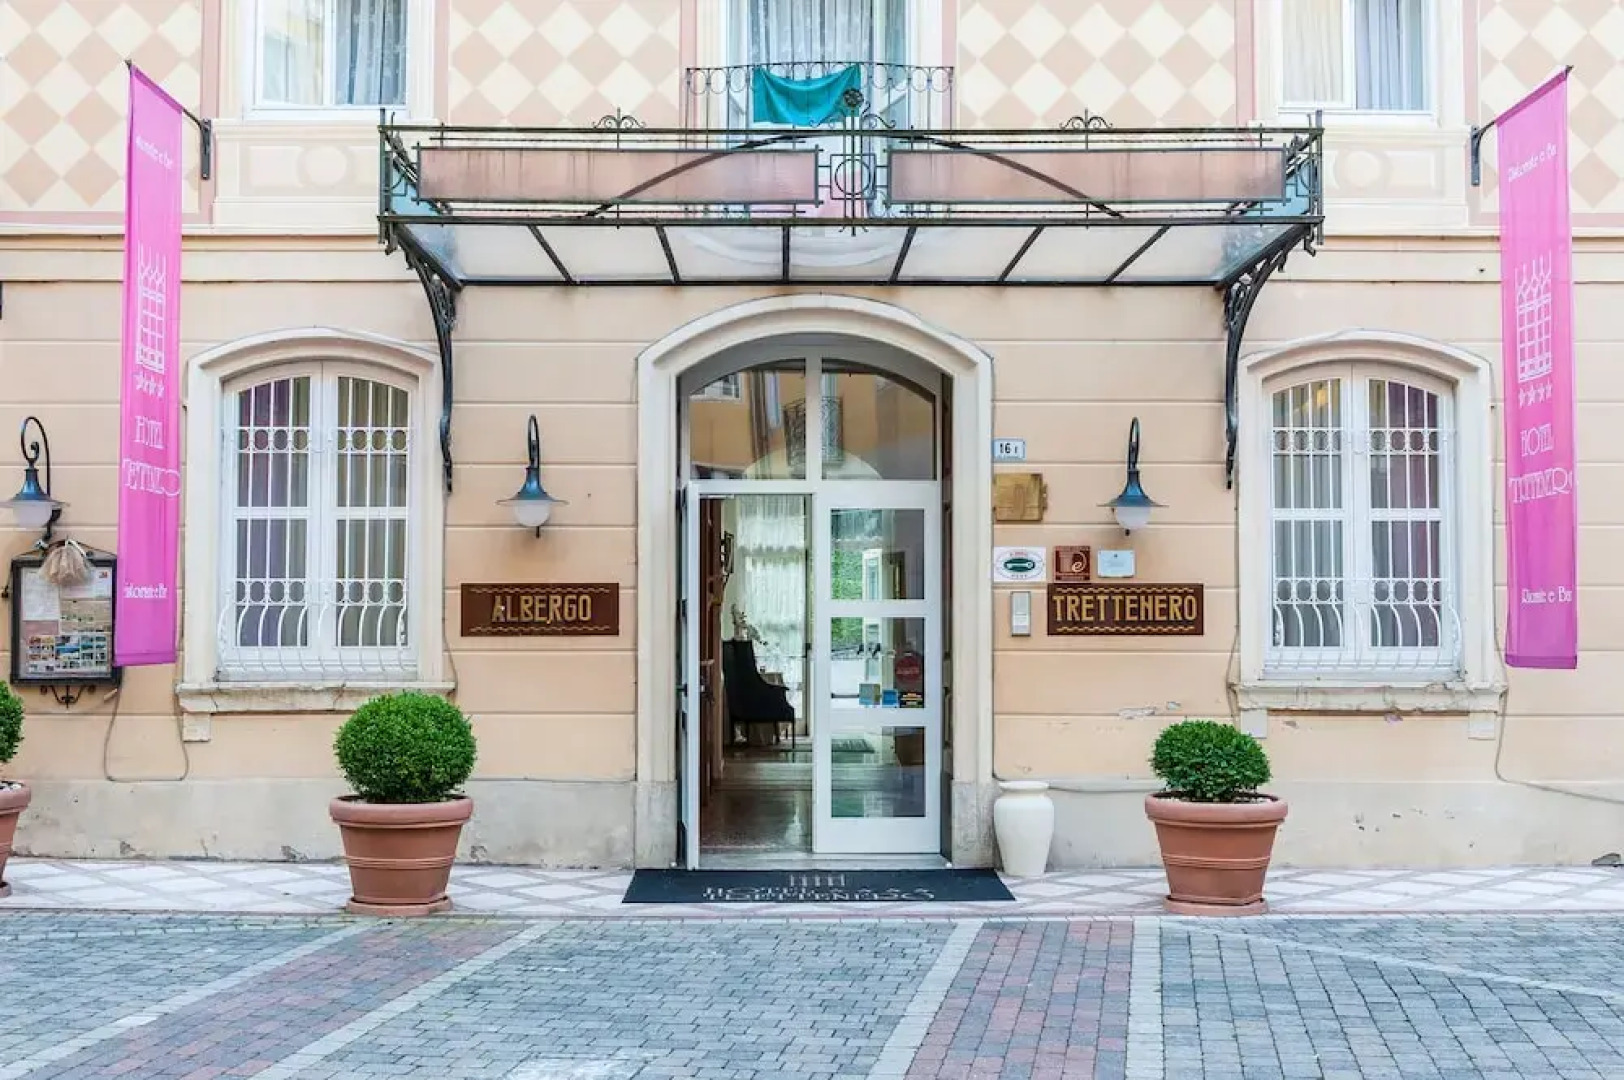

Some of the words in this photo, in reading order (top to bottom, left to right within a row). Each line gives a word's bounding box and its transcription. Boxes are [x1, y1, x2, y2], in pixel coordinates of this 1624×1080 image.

[1000, 442, 1012, 454] 16
[491, 595, 592, 622] ALBERGO
[1052, 595, 1198, 622] TRETTENERO
